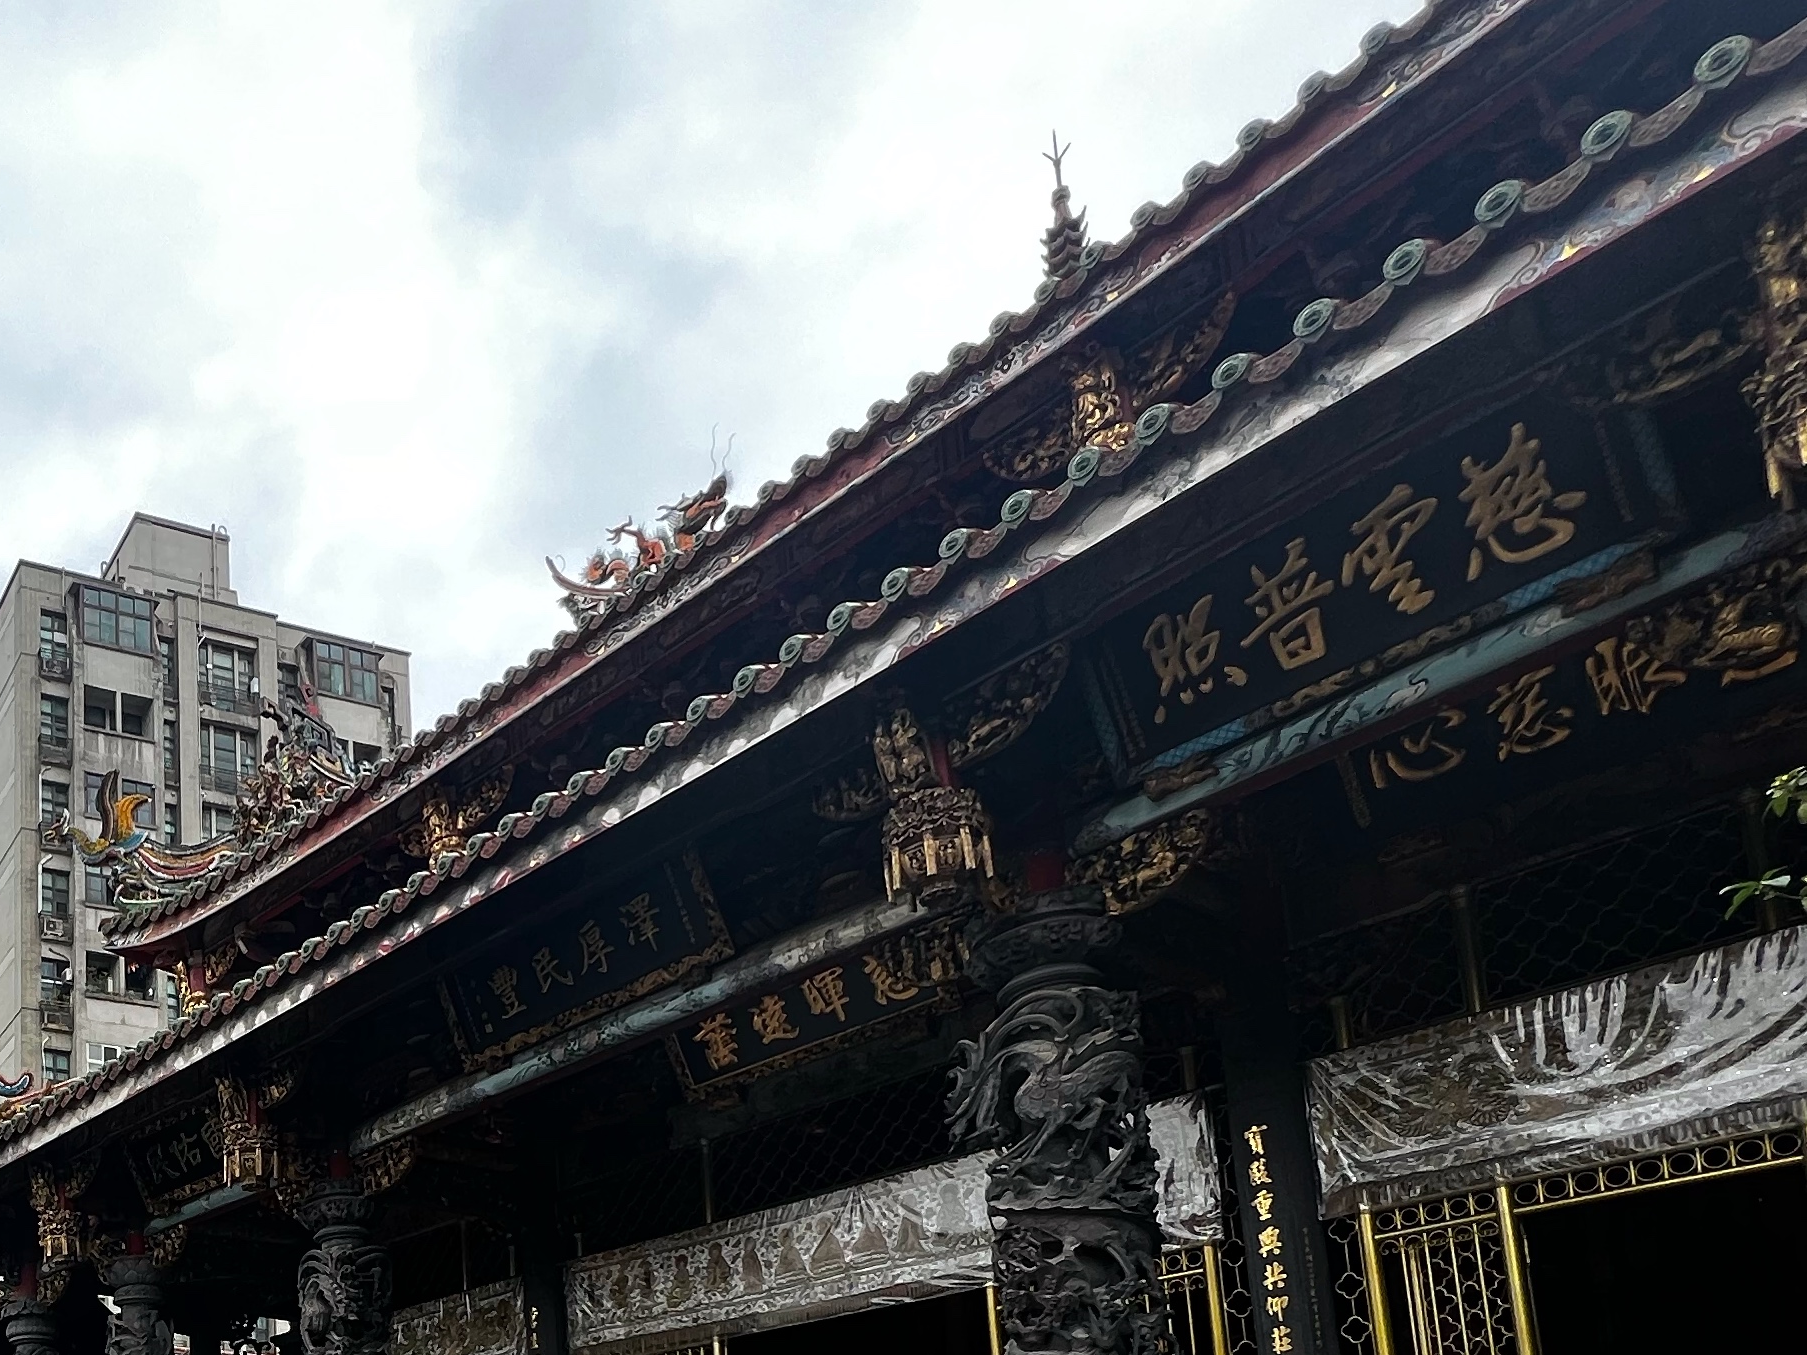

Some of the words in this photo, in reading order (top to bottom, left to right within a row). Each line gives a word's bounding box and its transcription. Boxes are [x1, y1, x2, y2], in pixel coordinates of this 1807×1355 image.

[1141, 421, 1587, 724] 慈雲普照
[1369, 634, 1797, 789] 眼慈心
[485, 891, 661, 1021] 澤厚民豐
